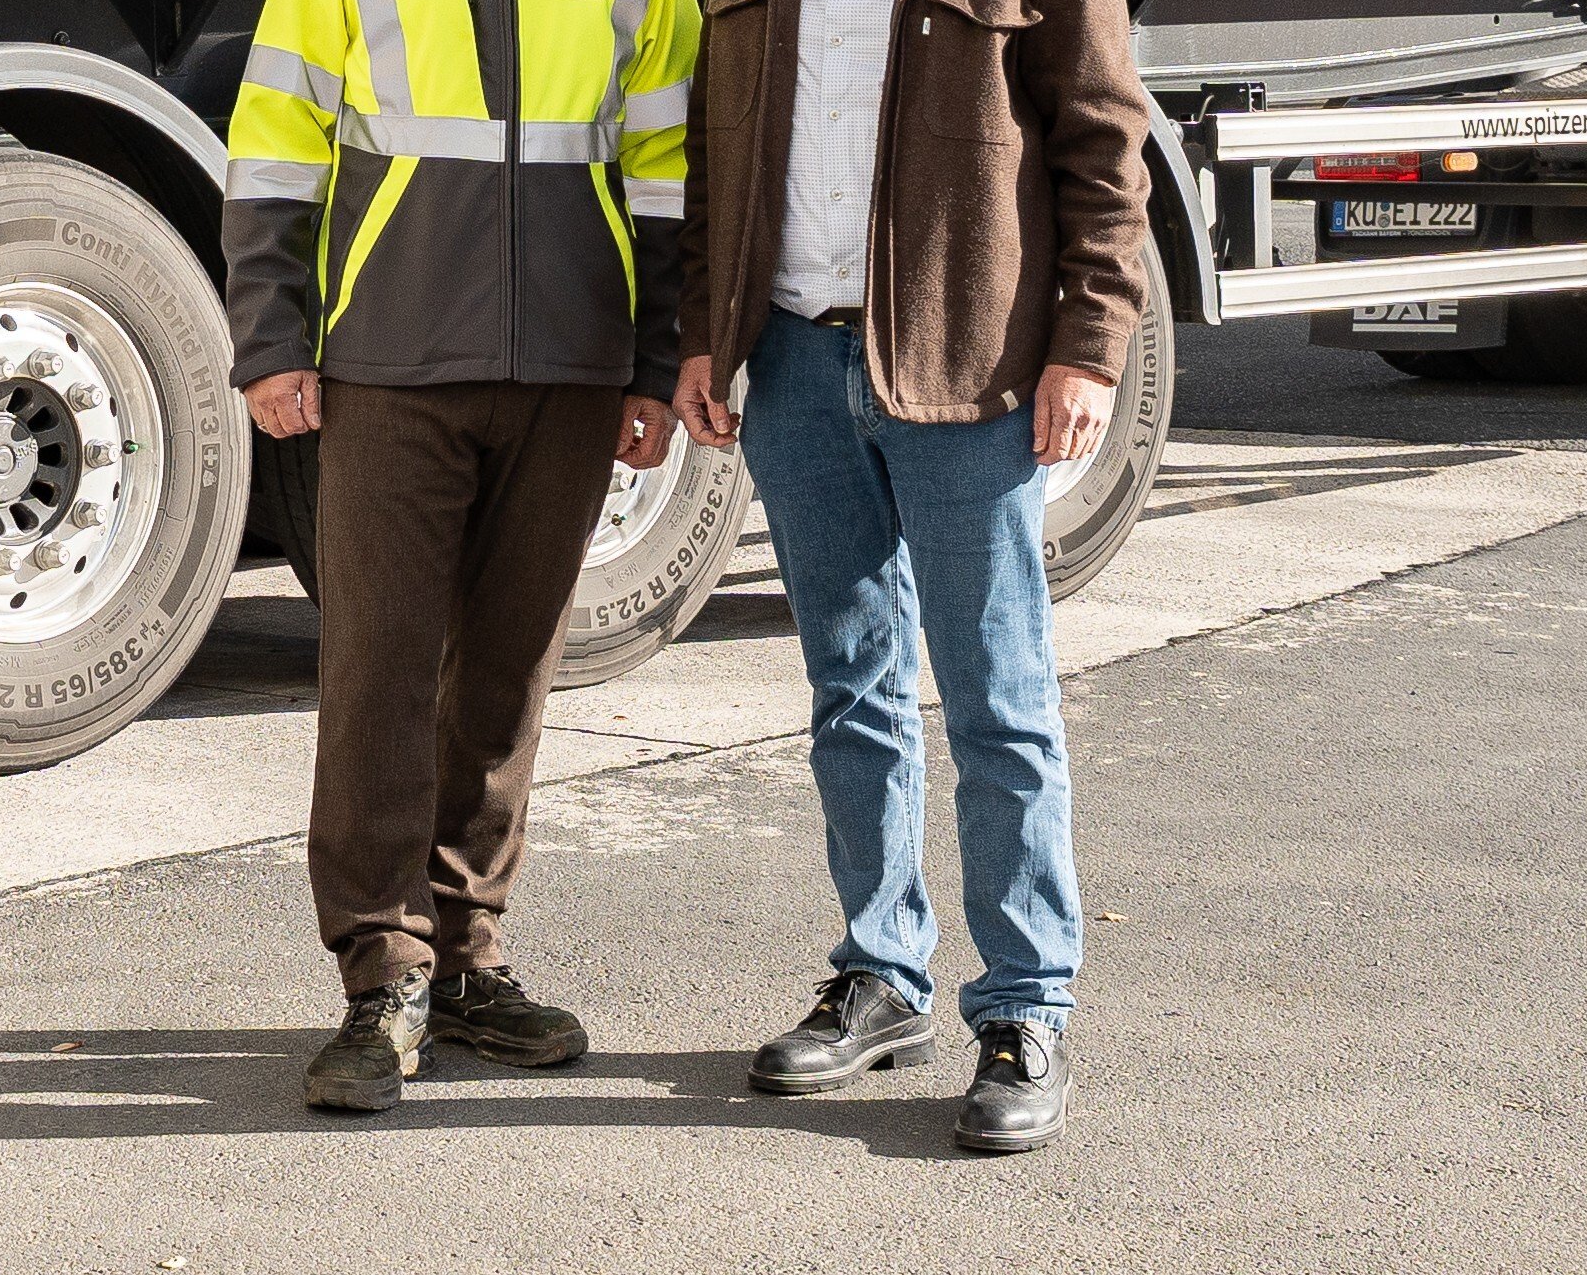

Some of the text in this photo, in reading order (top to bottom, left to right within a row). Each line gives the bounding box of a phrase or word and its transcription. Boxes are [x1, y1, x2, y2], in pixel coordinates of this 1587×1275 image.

[1347, 202, 1376, 227] KU
[1428, 203, 1473, 227] 222
[61, 221, 130, 271] Conti
[131, 263, 207, 356] Hybrid
[1352, 300, 1459, 321] DAF
[596, 488, 723, 627] 385/65 R 22.5
[51, 637, 144, 704] 385/65
[25, 684, 44, 708] R
